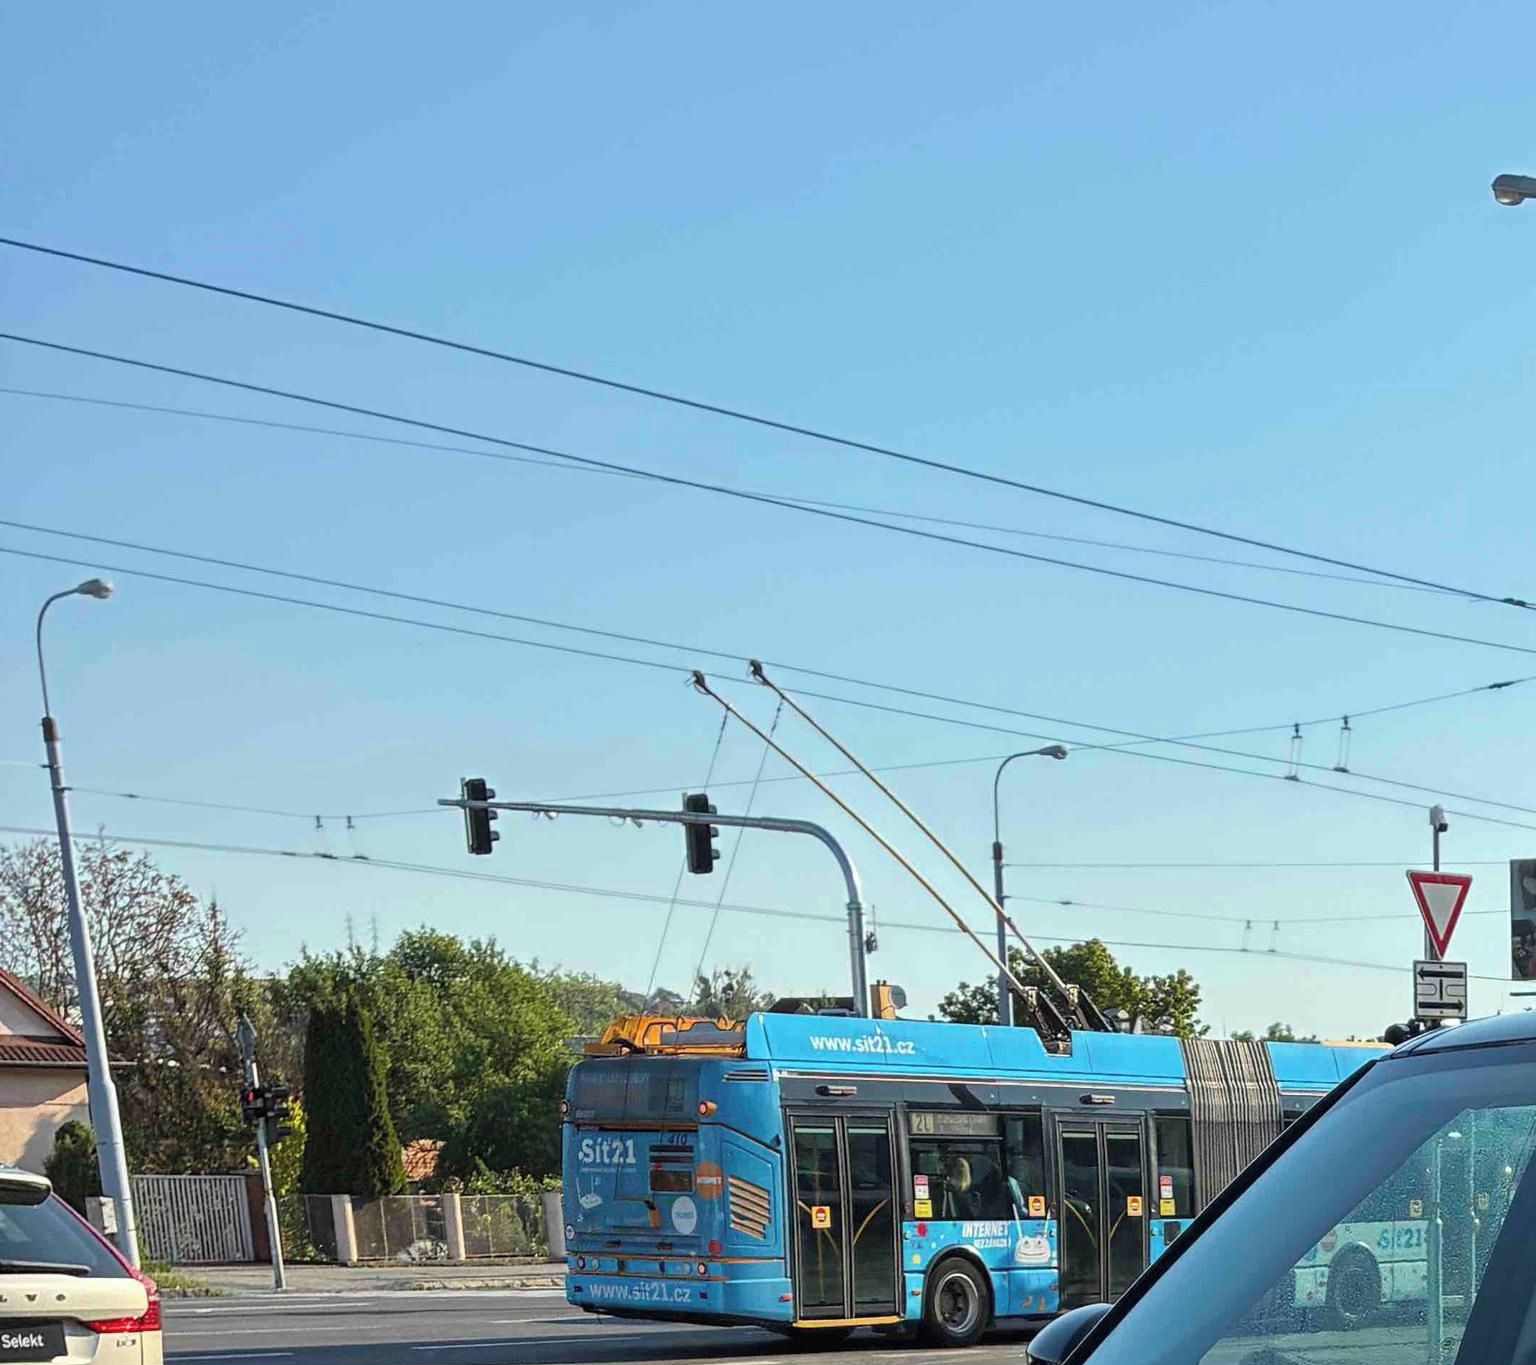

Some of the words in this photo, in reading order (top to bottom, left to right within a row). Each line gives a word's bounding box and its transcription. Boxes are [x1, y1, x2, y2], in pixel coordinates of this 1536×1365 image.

[809, 1034, 916, 1055] www.sit21.cz
[962, 1221, 1008, 1238] INTERNET
[589, 1281, 692, 1303] www.sit21.cz
[1, 1333, 45, 1349] Selekt
